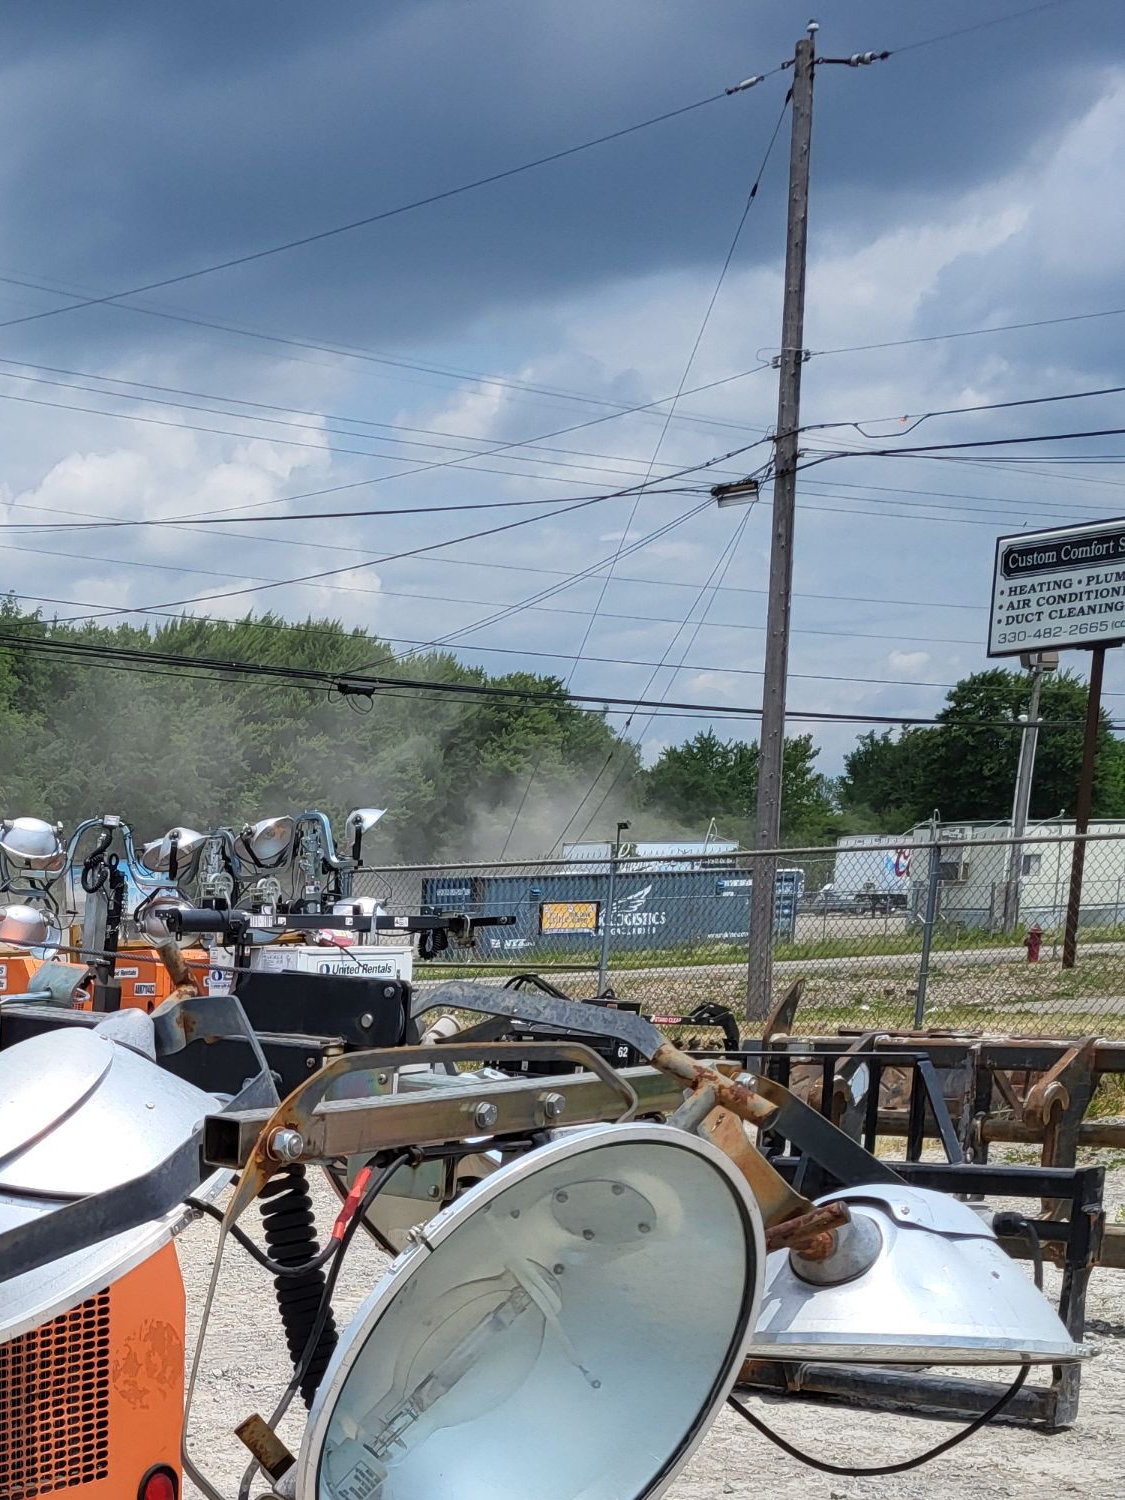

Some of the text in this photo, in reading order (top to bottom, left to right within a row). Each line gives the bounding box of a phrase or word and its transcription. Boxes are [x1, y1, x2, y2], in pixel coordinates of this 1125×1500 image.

[1008, 551, 1057, 569] Custom
[1061, 540, 1115, 561] Comfort
[1007, 579, 1073, 597] HEATING
[1005, 601, 1124, 626] DUCT CLEANING
[1006, 599, 1031, 611] AIR
[997, 620, 1109, 644] 330-482-2665
[332, 962, 392, 975] United Rentals
[618, 1046, 629, 1058] 62
